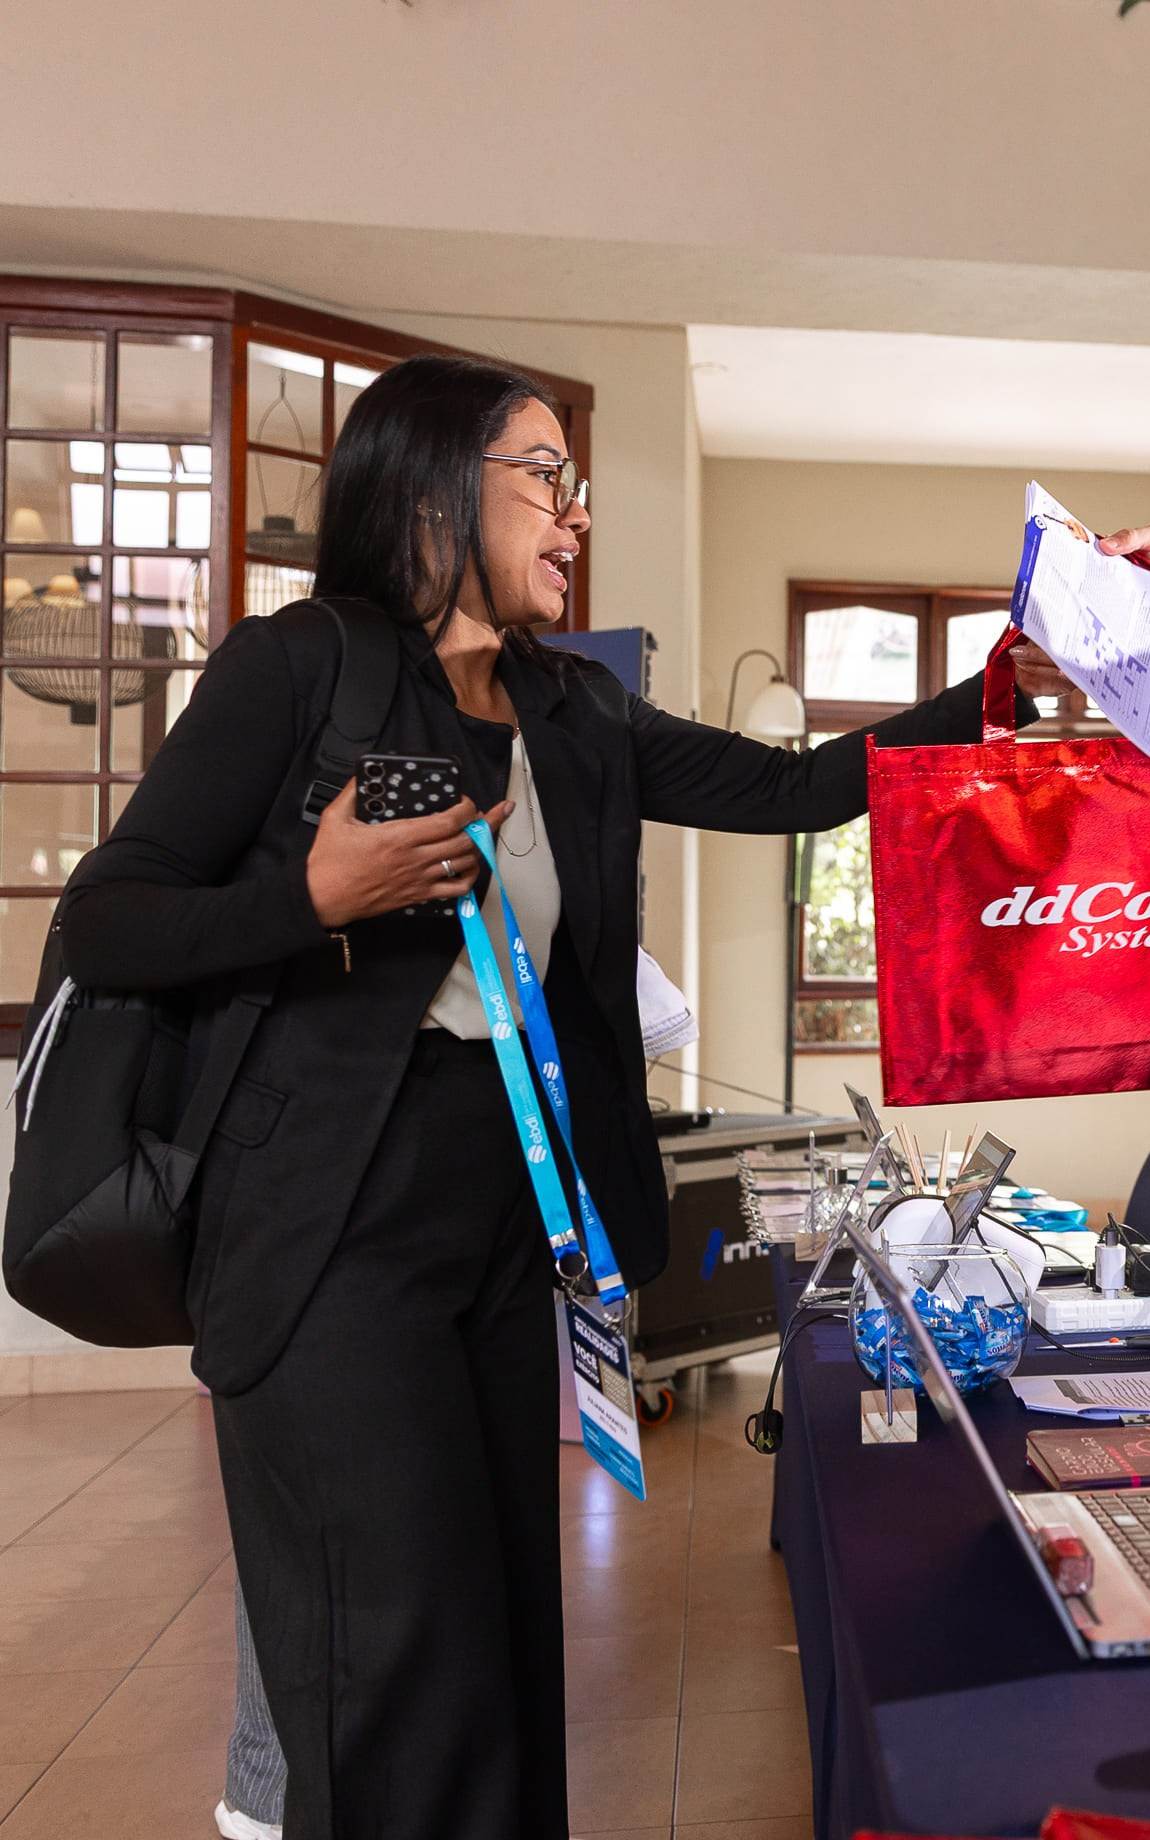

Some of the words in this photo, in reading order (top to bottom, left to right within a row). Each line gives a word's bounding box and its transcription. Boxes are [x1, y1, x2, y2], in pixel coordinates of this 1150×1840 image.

[517, 956, 533, 984] ebdi
[489, 994, 508, 1021] ebdi
[547, 1081, 564, 1107] ebdi
[524, 1116, 543, 1144] ebdi
[573, 1341, 597, 1370] VOCÊ
